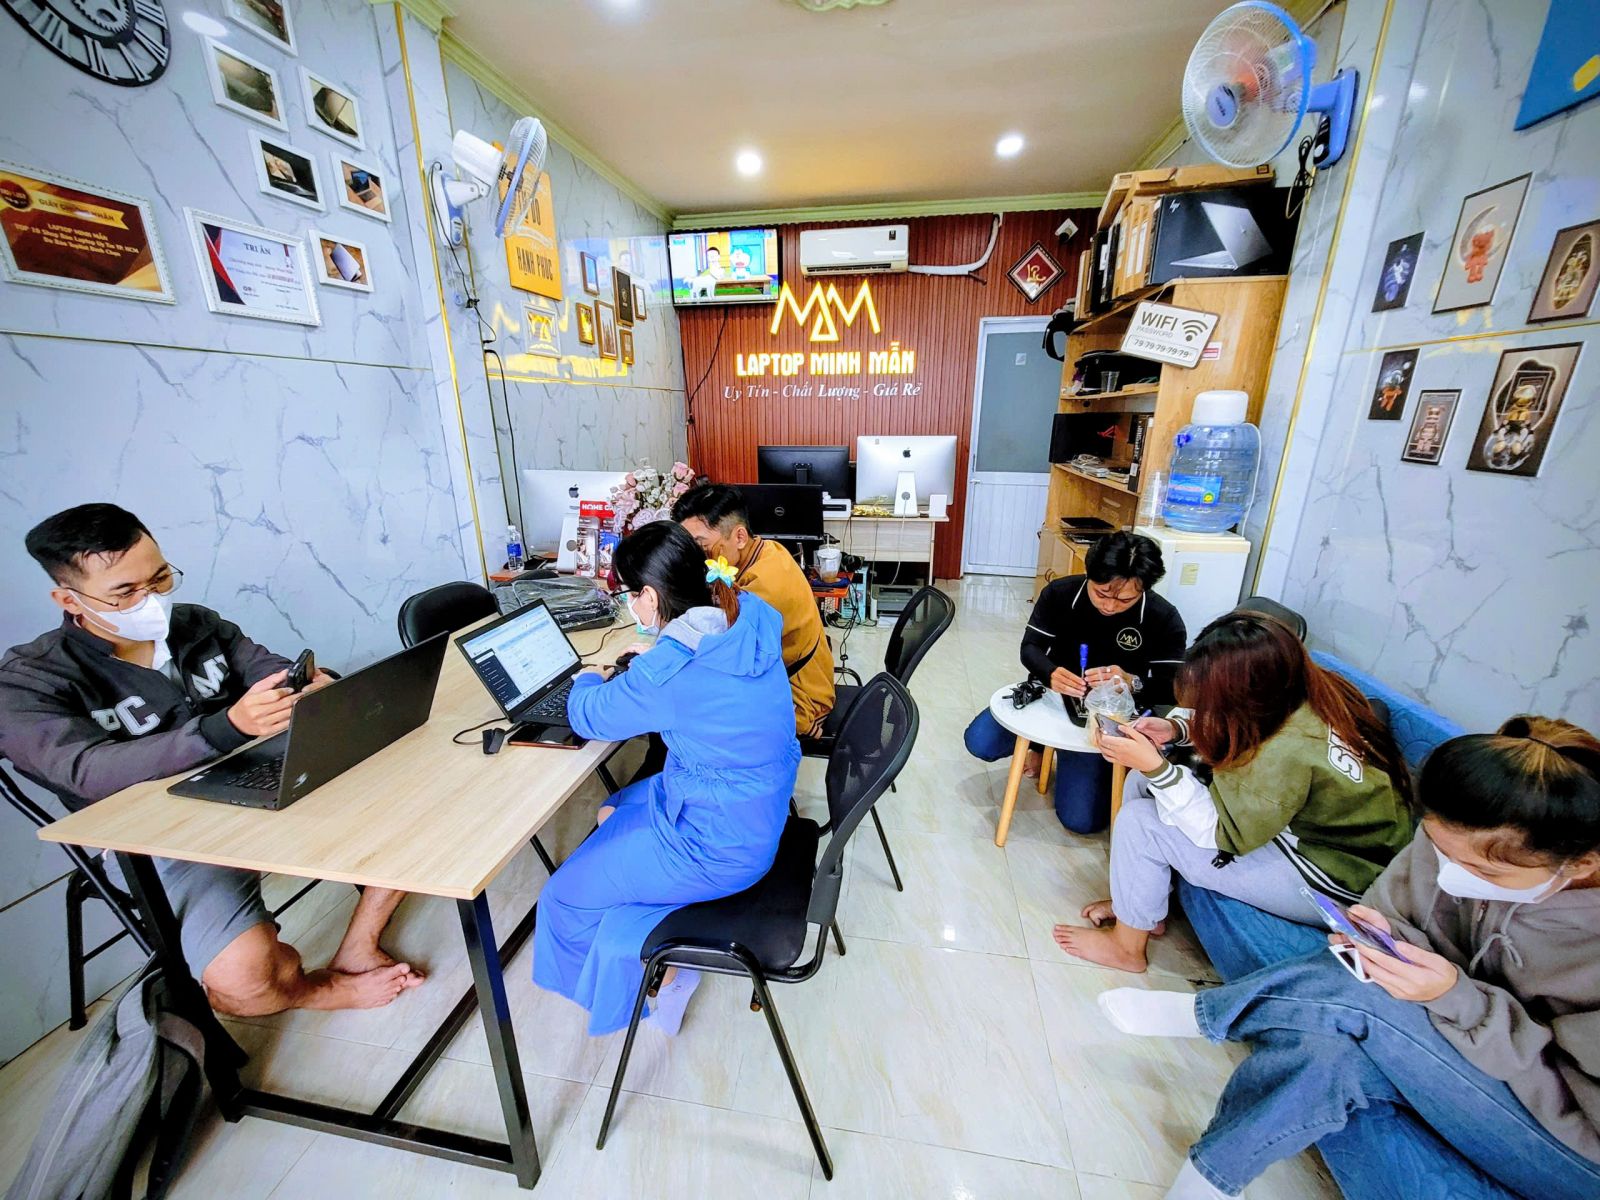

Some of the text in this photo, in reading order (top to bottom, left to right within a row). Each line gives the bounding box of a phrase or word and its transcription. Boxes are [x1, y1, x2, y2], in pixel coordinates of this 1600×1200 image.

[1141, 311, 1179, 331] WIFI
[736, 341, 915, 377] LAPTOP MINH MẪN
[724, 386, 742, 402] Uy
[747, 384, 770, 398] Tín
[782, 381, 812, 398] Chất
[818, 383, 861, 401] Lượng
[873, 383, 898, 396] Giá
[902, 382, 922, 396] Rẻ
[581, 503, 603, 511] HOME
